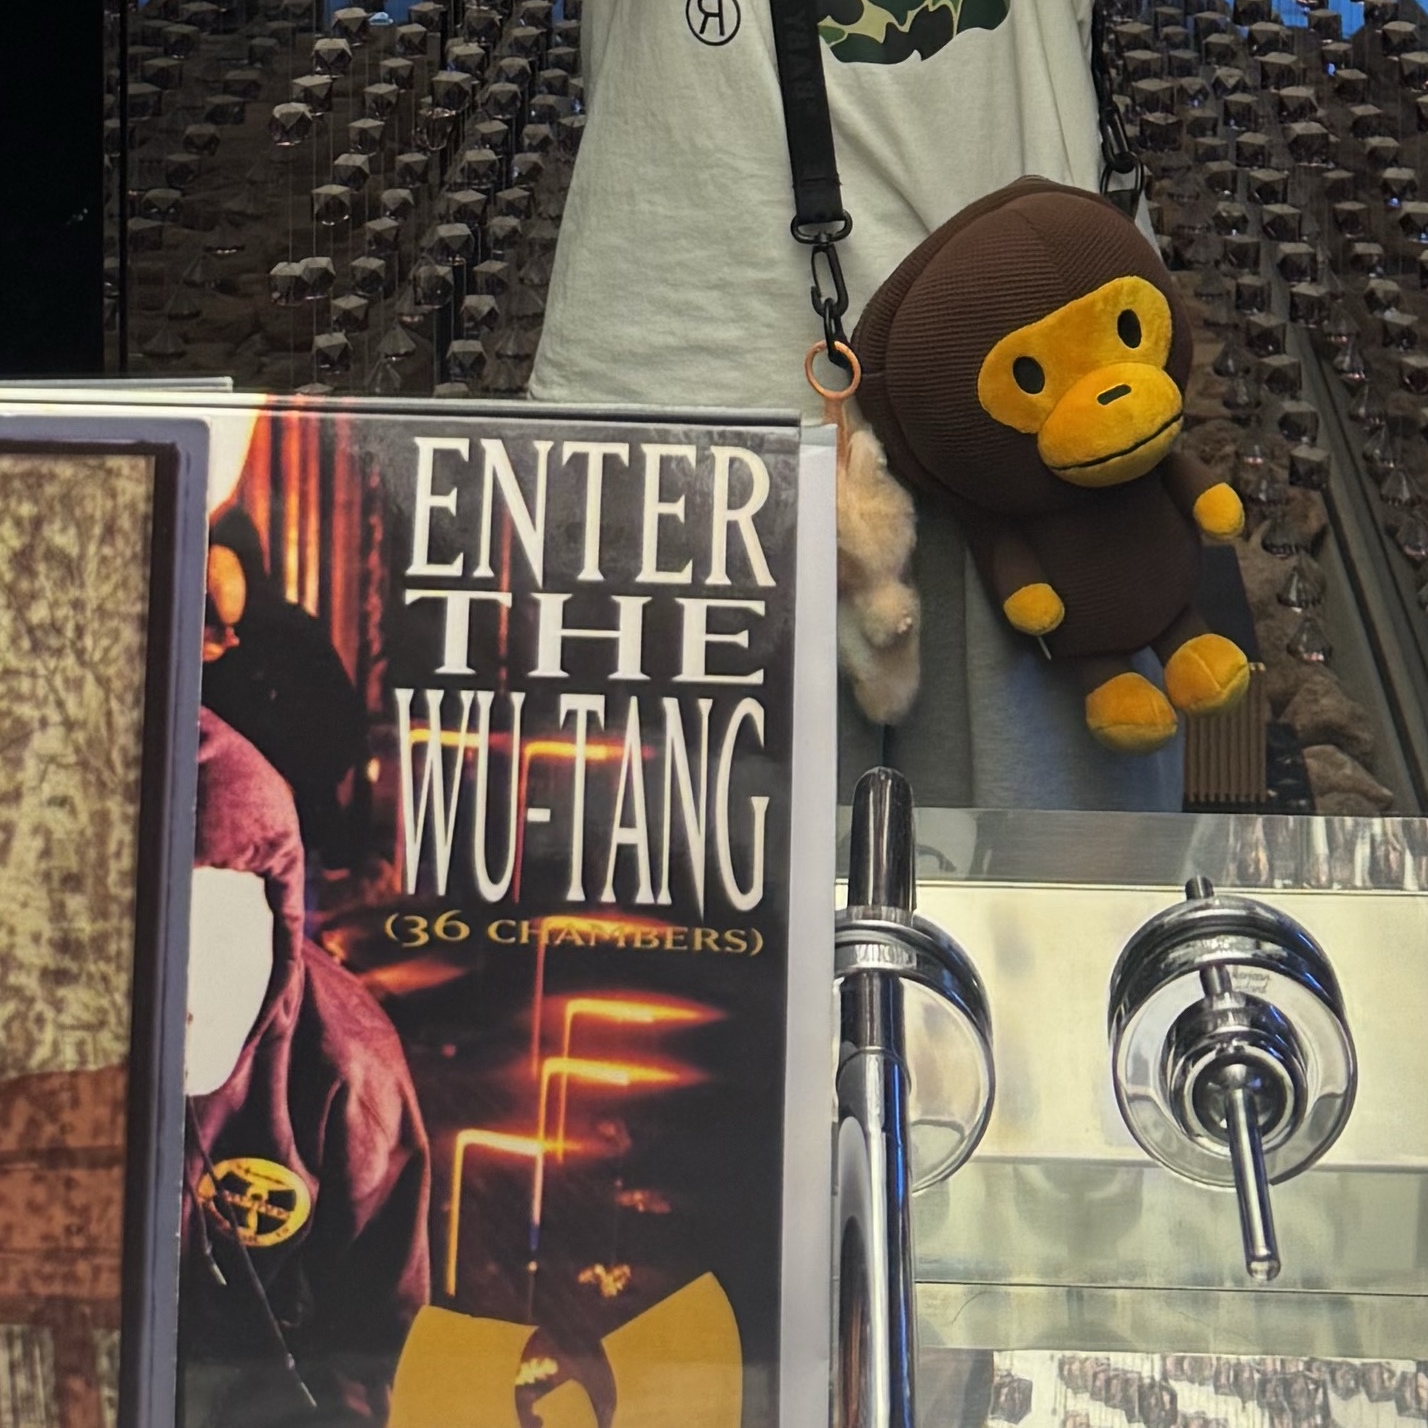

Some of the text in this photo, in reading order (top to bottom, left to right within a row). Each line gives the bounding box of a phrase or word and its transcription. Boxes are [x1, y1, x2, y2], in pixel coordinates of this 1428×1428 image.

[405, 436, 776, 588] ENTER
[404, 589, 766, 686] THE
[395, 688, 770, 918] WU-TANG
[384, 911, 766, 957] (36 CHAMBERS)
